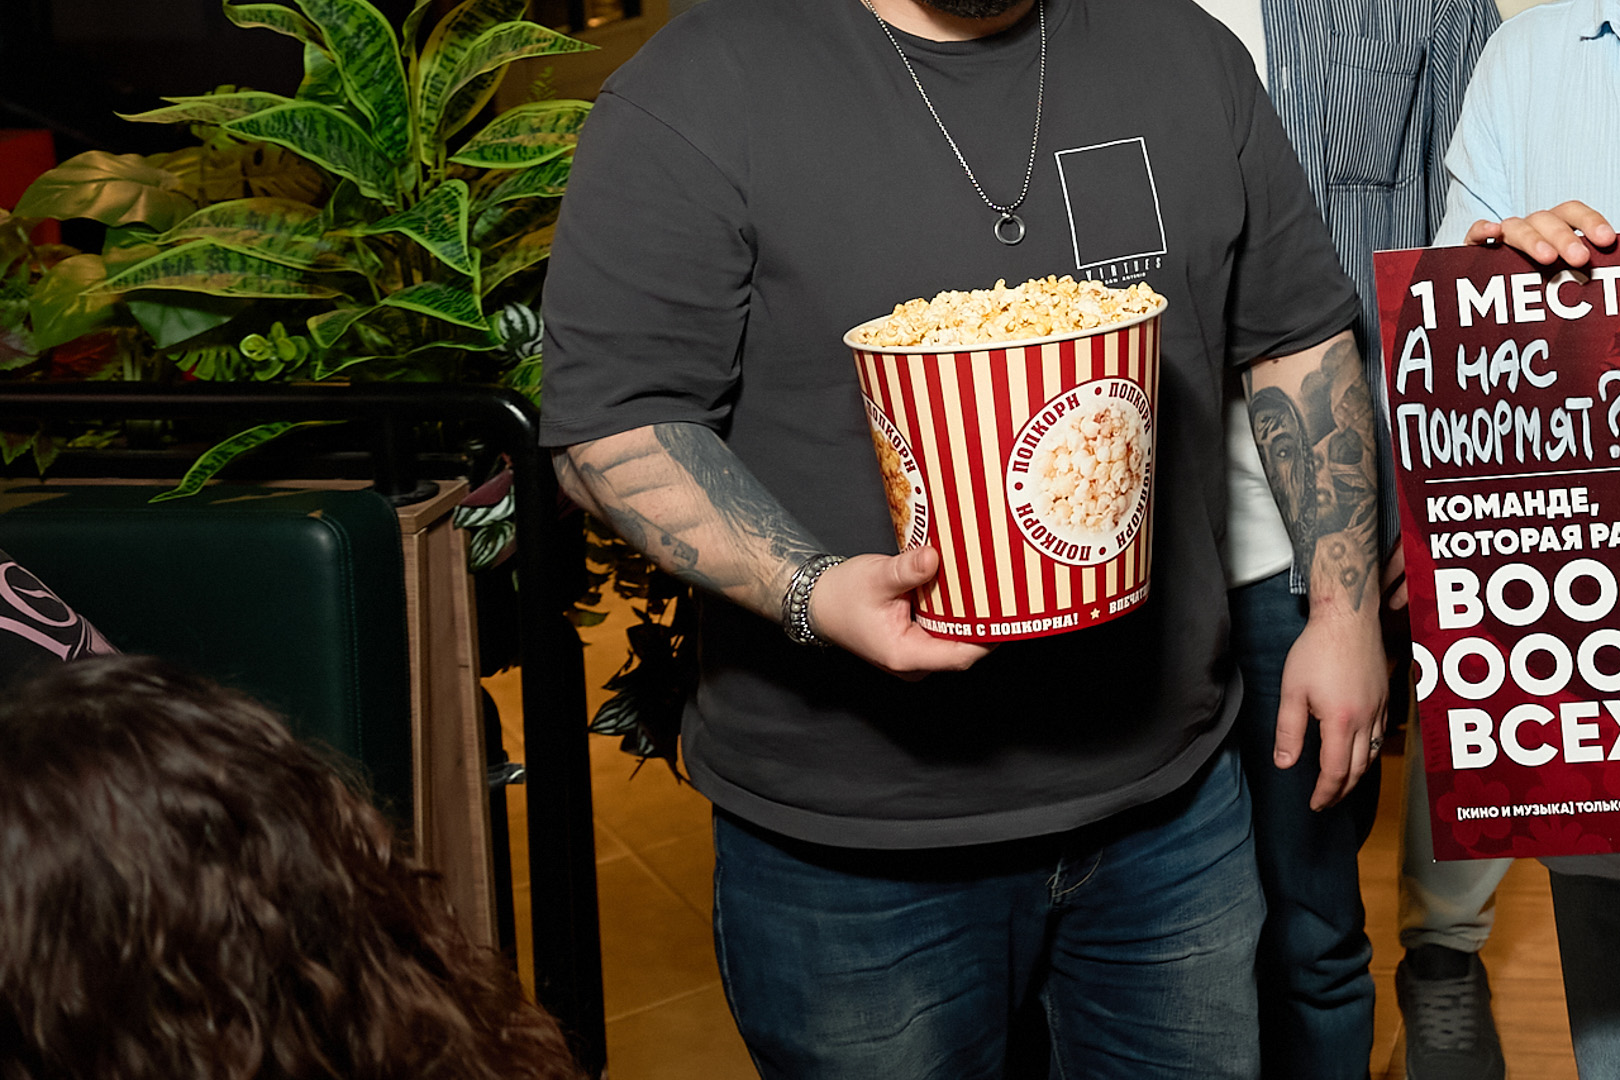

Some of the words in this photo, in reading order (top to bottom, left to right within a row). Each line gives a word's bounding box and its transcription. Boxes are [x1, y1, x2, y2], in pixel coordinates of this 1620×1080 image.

[1409, 280, 1438, 330] 1
[1395, 324, 1434, 396] А
[1012, 393, 1081, 474] ПОПКОРН
[1108, 382, 1151, 435] ПОПКОРН
[903, 502, 926, 552] ПОПК
[1426, 487, 1600, 524] КОМАНДЕ,
[1015, 502, 1092, 562] ПОПКОРН
[1430, 524, 1583, 559] КОТОРАЯ
[976, 623, 987, 637] С
[990, 612, 1079, 636] ПОПКОРНА!
[1456, 807, 1500, 821] [КИНО
[1501, 806, 1511, 818] И
[1513, 801, 1575, 817] МУЗЫКА]
